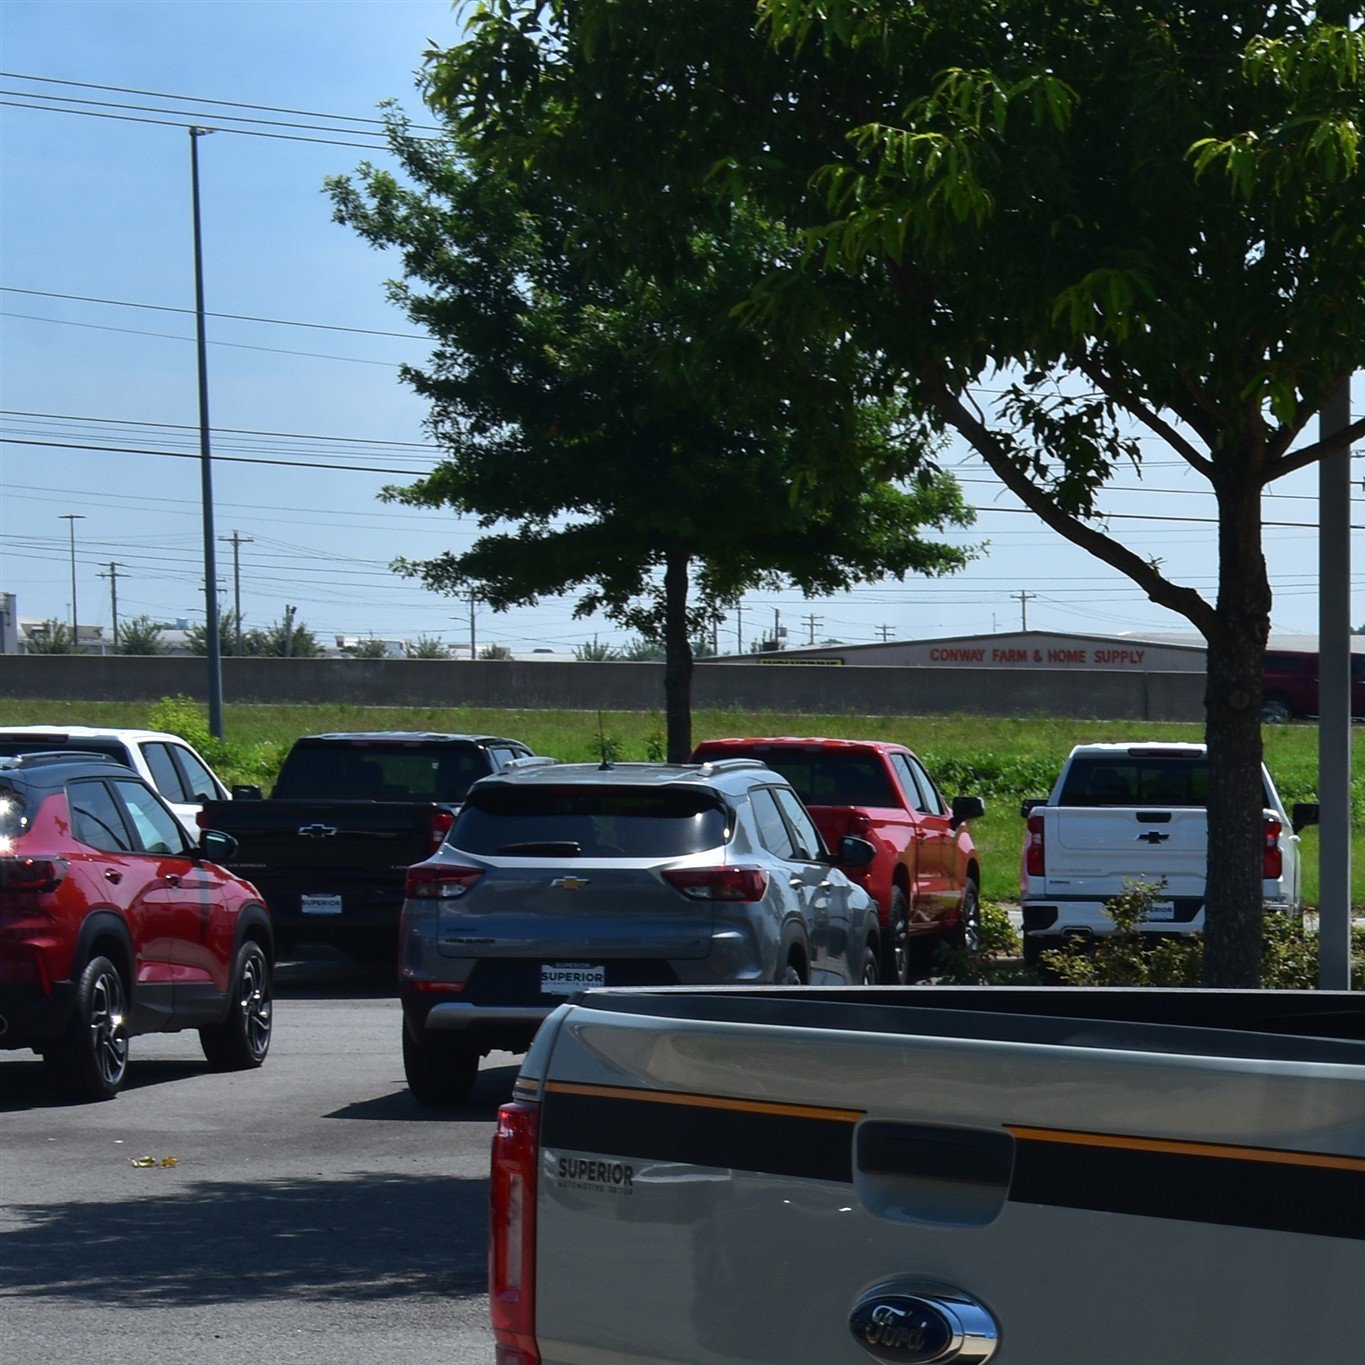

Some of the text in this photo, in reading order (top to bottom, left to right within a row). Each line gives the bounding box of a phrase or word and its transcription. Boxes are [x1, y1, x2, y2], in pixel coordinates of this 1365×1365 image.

[930, 648, 1145, 664] CONWAY FARM & HOME SUPPLY
[541, 972, 604, 982] SUPERIOR
[558, 1157, 634, 1186] SUPERIOR
[865, 1303, 926, 1351] Ford
